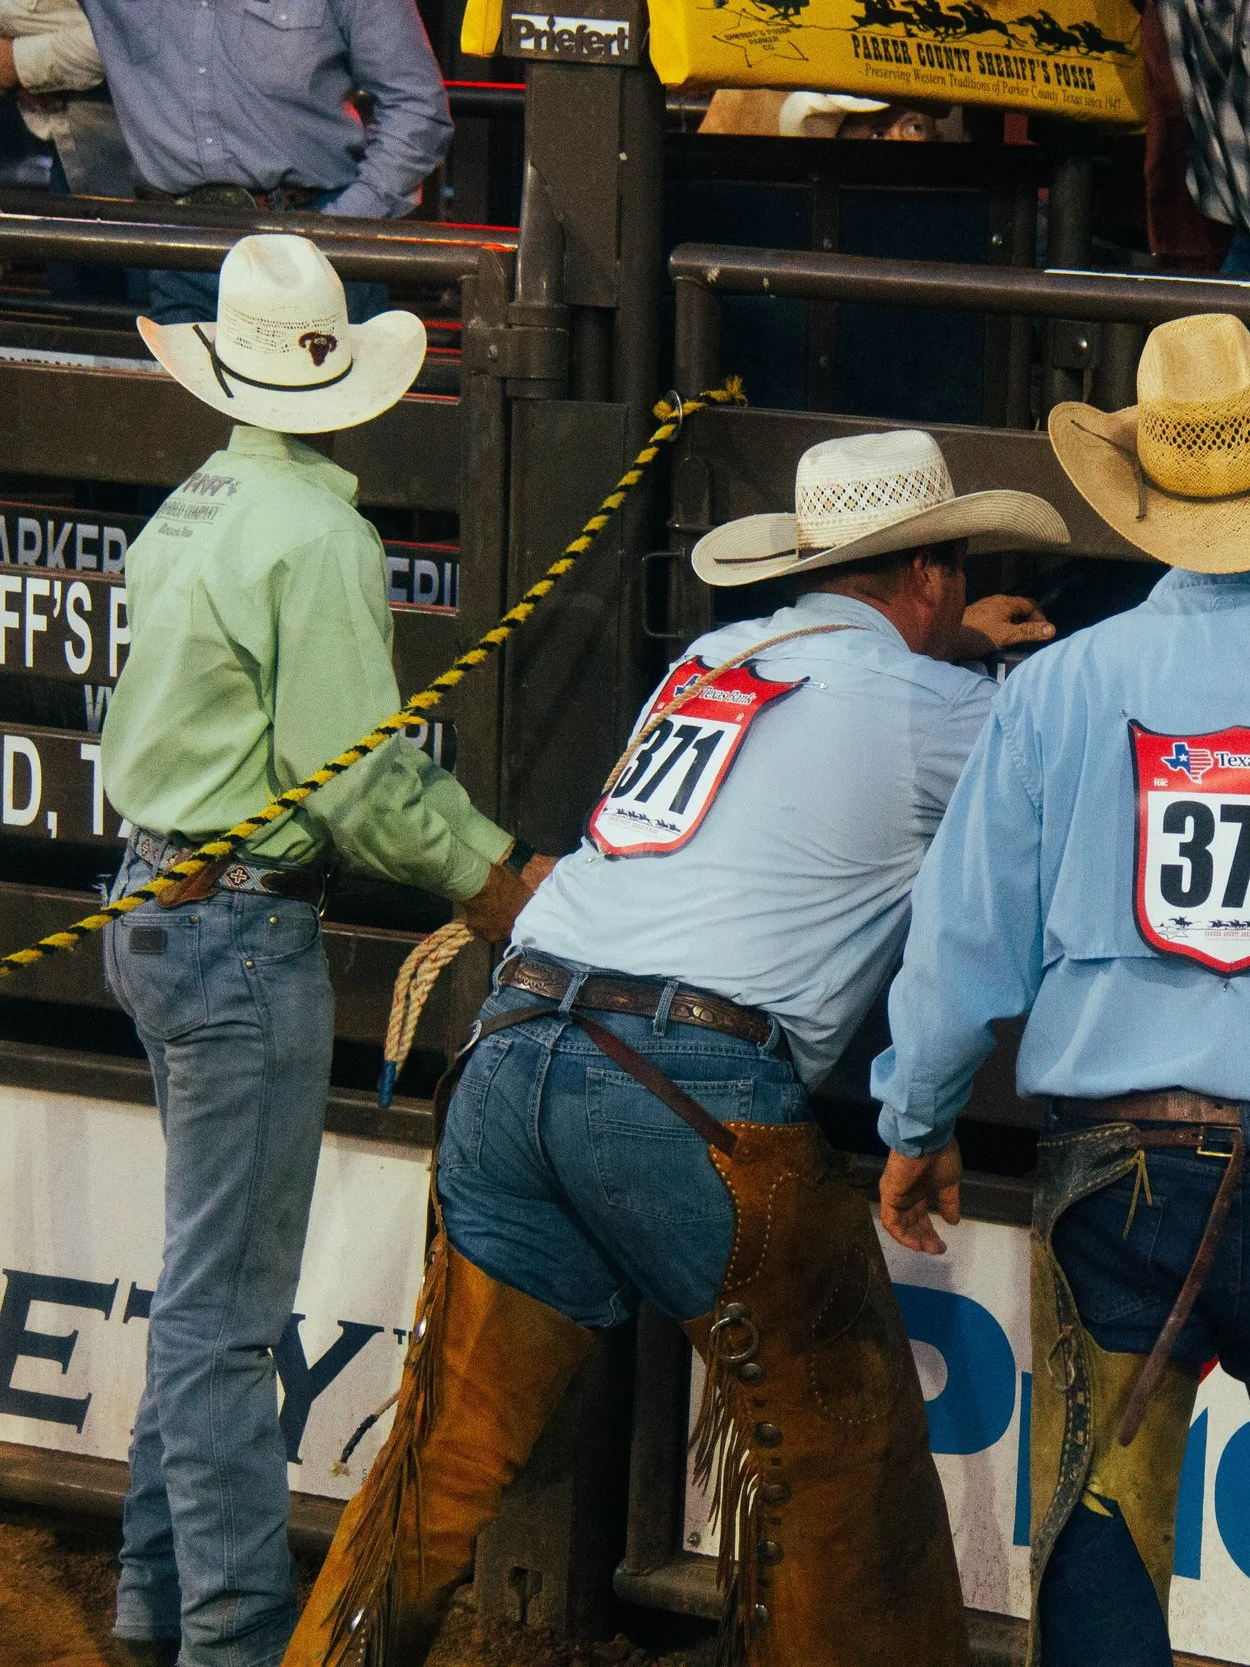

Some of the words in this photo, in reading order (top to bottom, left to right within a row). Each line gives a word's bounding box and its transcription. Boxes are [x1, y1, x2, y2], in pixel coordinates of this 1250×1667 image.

[511, 15, 629, 55] Priefert
[850, 33, 913, 66] PARKER
[916, 42, 972, 73] COUNTY
[976, 51, 1051, 84] SHERIFF'S
[1054, 62, 1096, 92] POSSE
[913, 67, 947, 87] Western
[949, 73, 991, 92] Traditions
[992, 79, 1002, 96] of
[1002, 79, 1030, 96] Parker
[700, 686, 729, 702] Texas
[727, 690, 757, 706] Bank
[611, 718, 726, 815] 371
